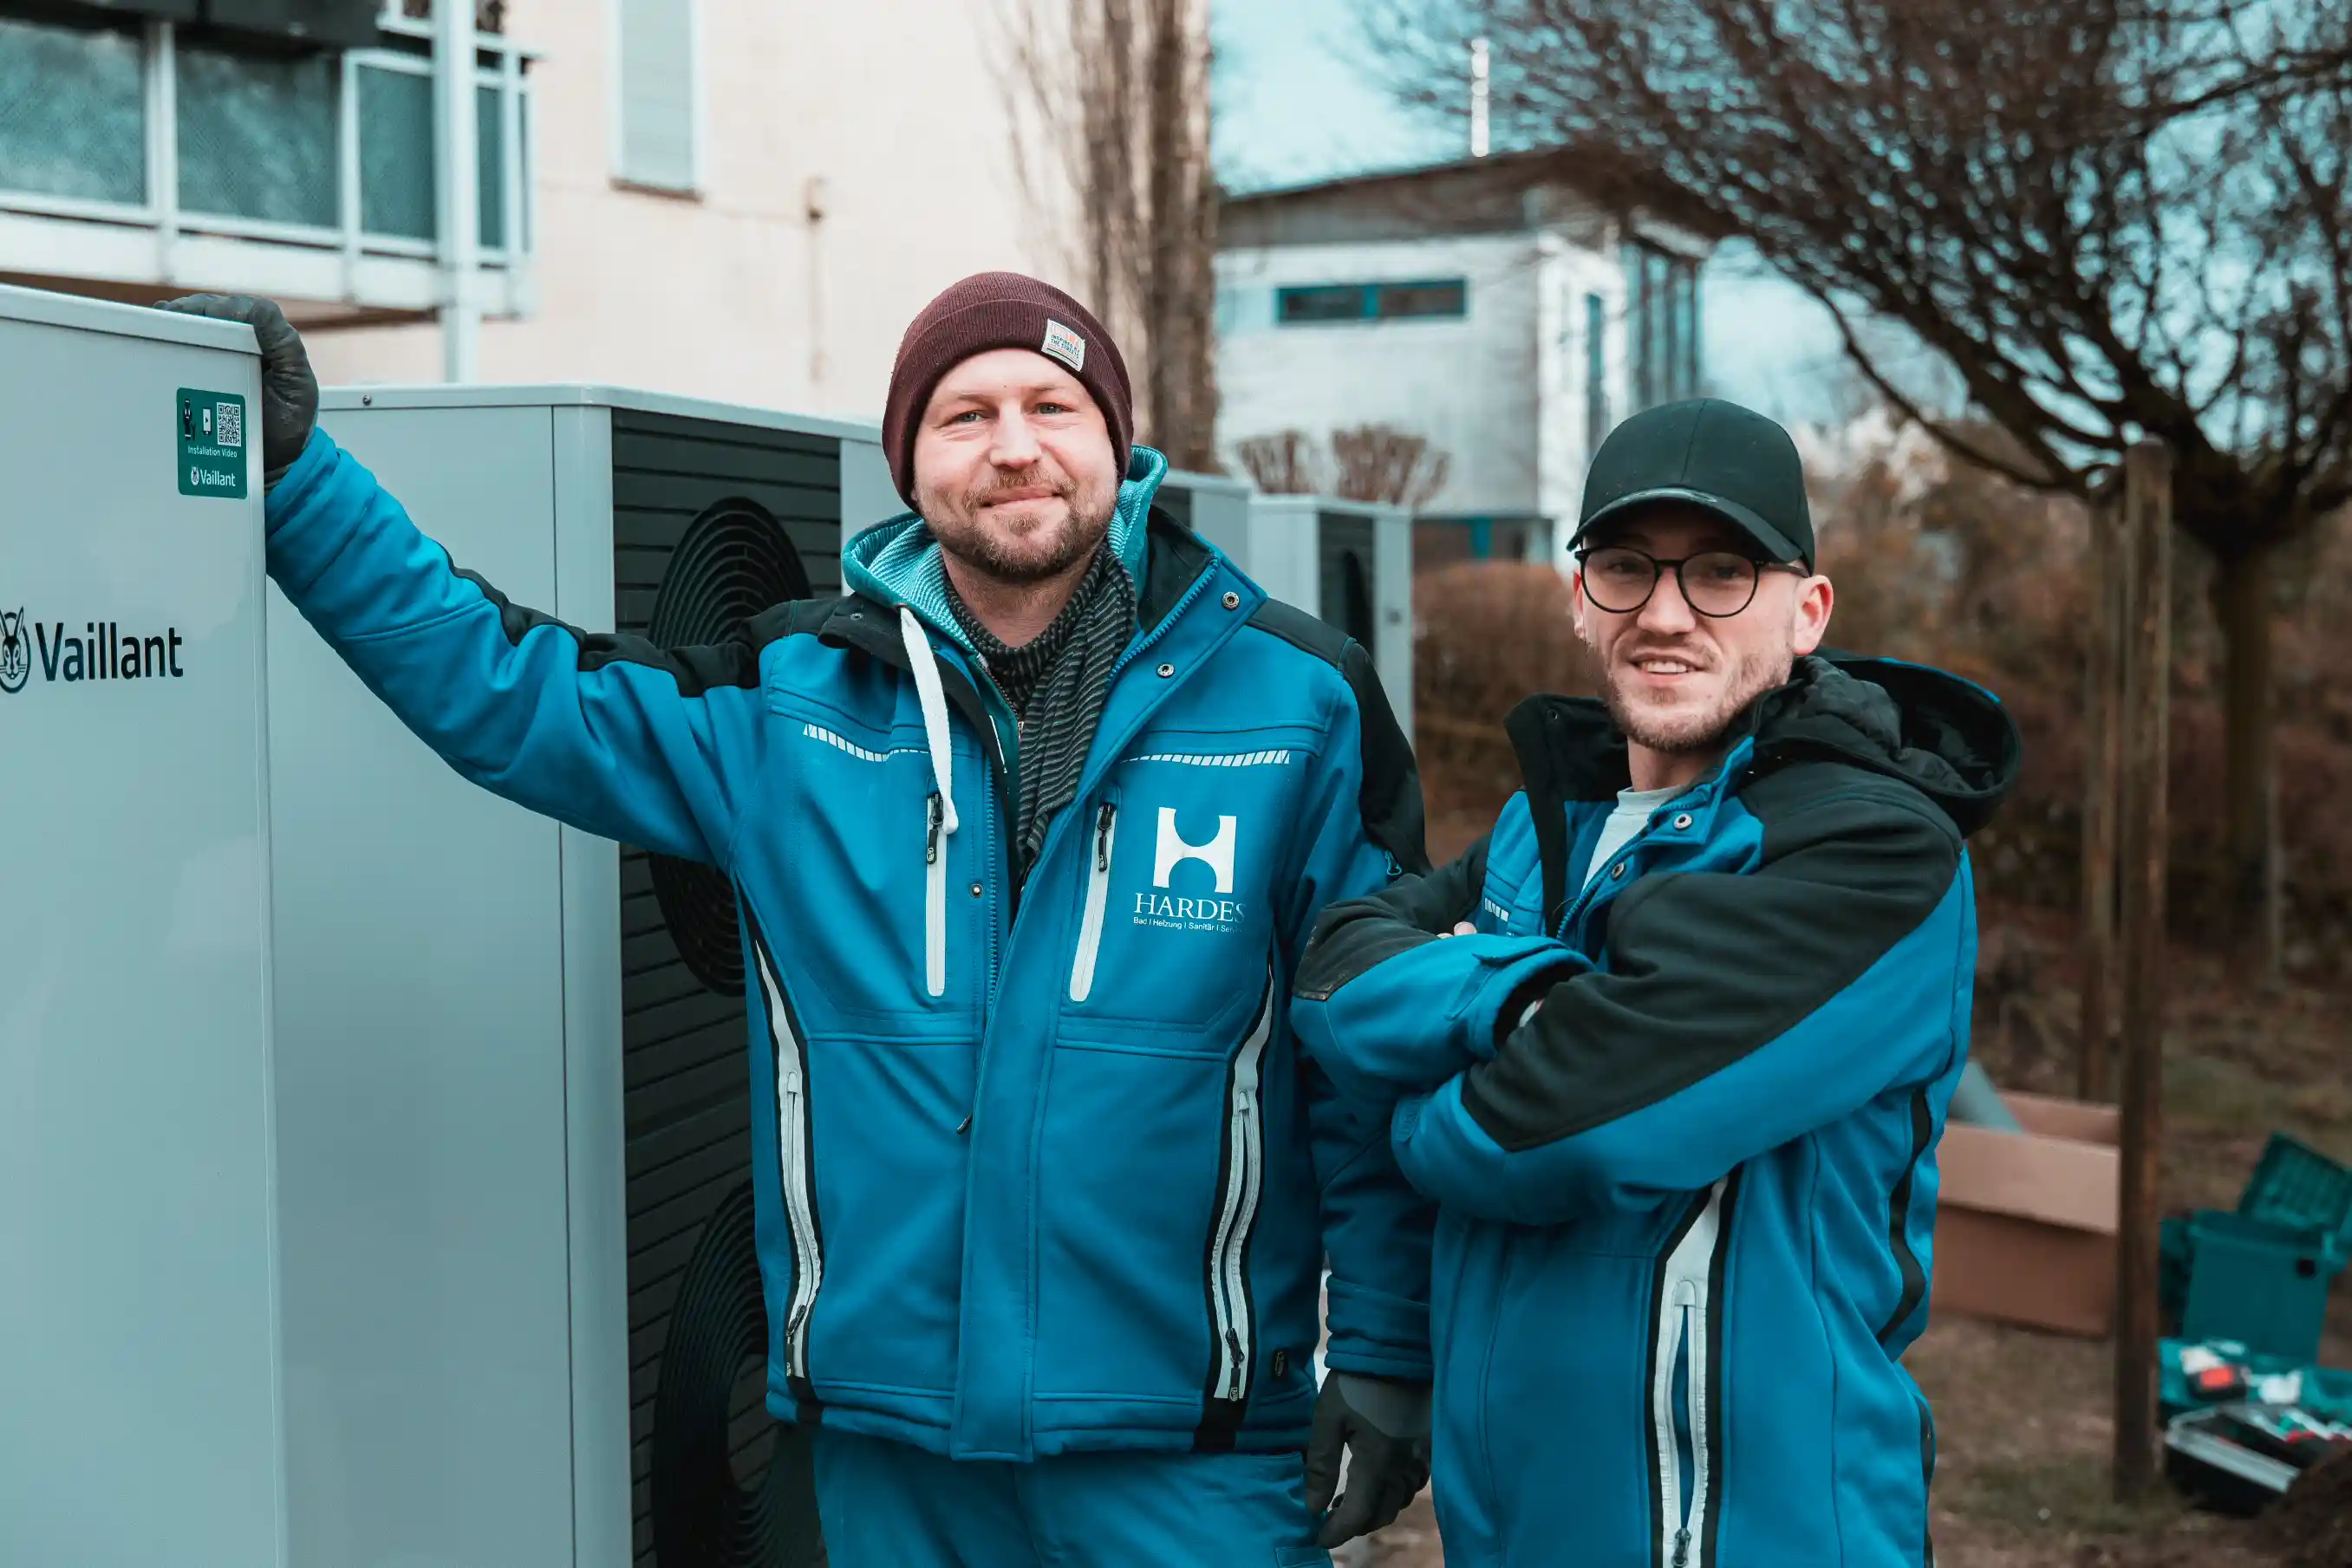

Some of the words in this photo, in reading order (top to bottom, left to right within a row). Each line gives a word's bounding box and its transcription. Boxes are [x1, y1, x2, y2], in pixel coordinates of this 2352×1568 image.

[187, 445, 221, 458] Installation
[221, 448, 238, 458] Video
[200, 469, 236, 487] Vaillant
[35, 621, 184, 683] Vaillant
[1134, 892, 1247, 923] HARDES
[1133, 916, 1147, 925] Bad
[1153, 919, 1183, 929] Heizung
[1189, 922, 1215, 932] Sanitär
